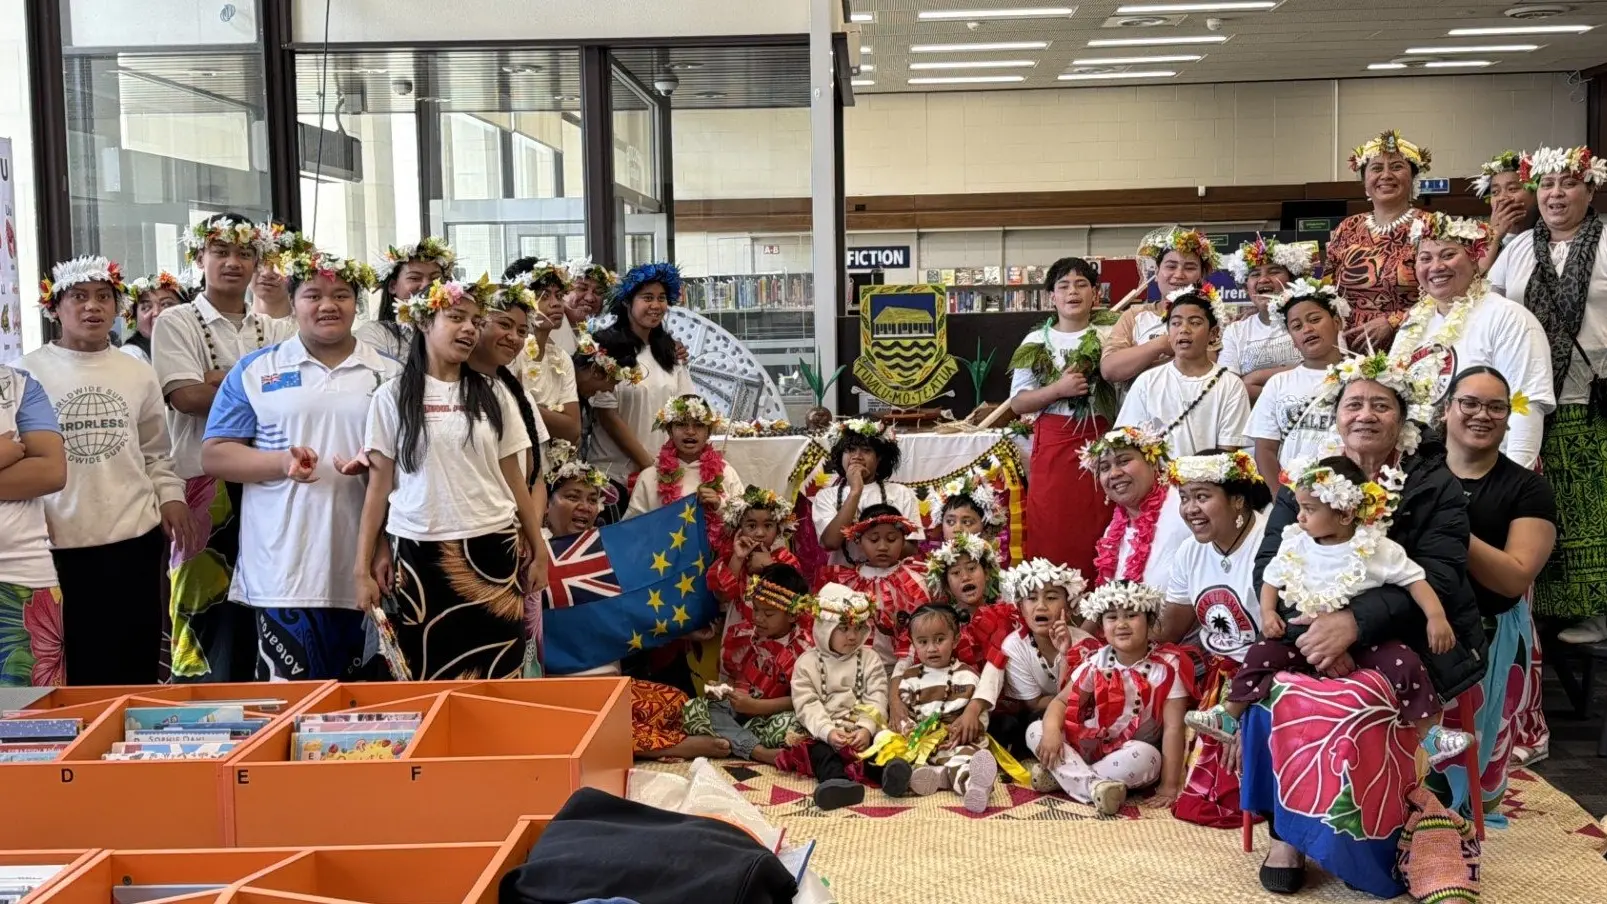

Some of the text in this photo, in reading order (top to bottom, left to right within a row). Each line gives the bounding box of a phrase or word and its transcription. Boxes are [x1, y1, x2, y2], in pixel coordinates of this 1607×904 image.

[847, 250, 904, 266] FICTION
[1218, 286, 1247, 299] dren
[855, 363, 891, 399] TUVALU
[892, 392, 911, 404] MO
[932, 365, 957, 391] ATUA
[54, 386, 130, 418] ORLDWIDE SUPPLY
[67, 454, 102, 464] DWIDE
[61, 768, 74, 783] D
[237, 769, 249, 784] E
[411, 766, 422, 781] F
